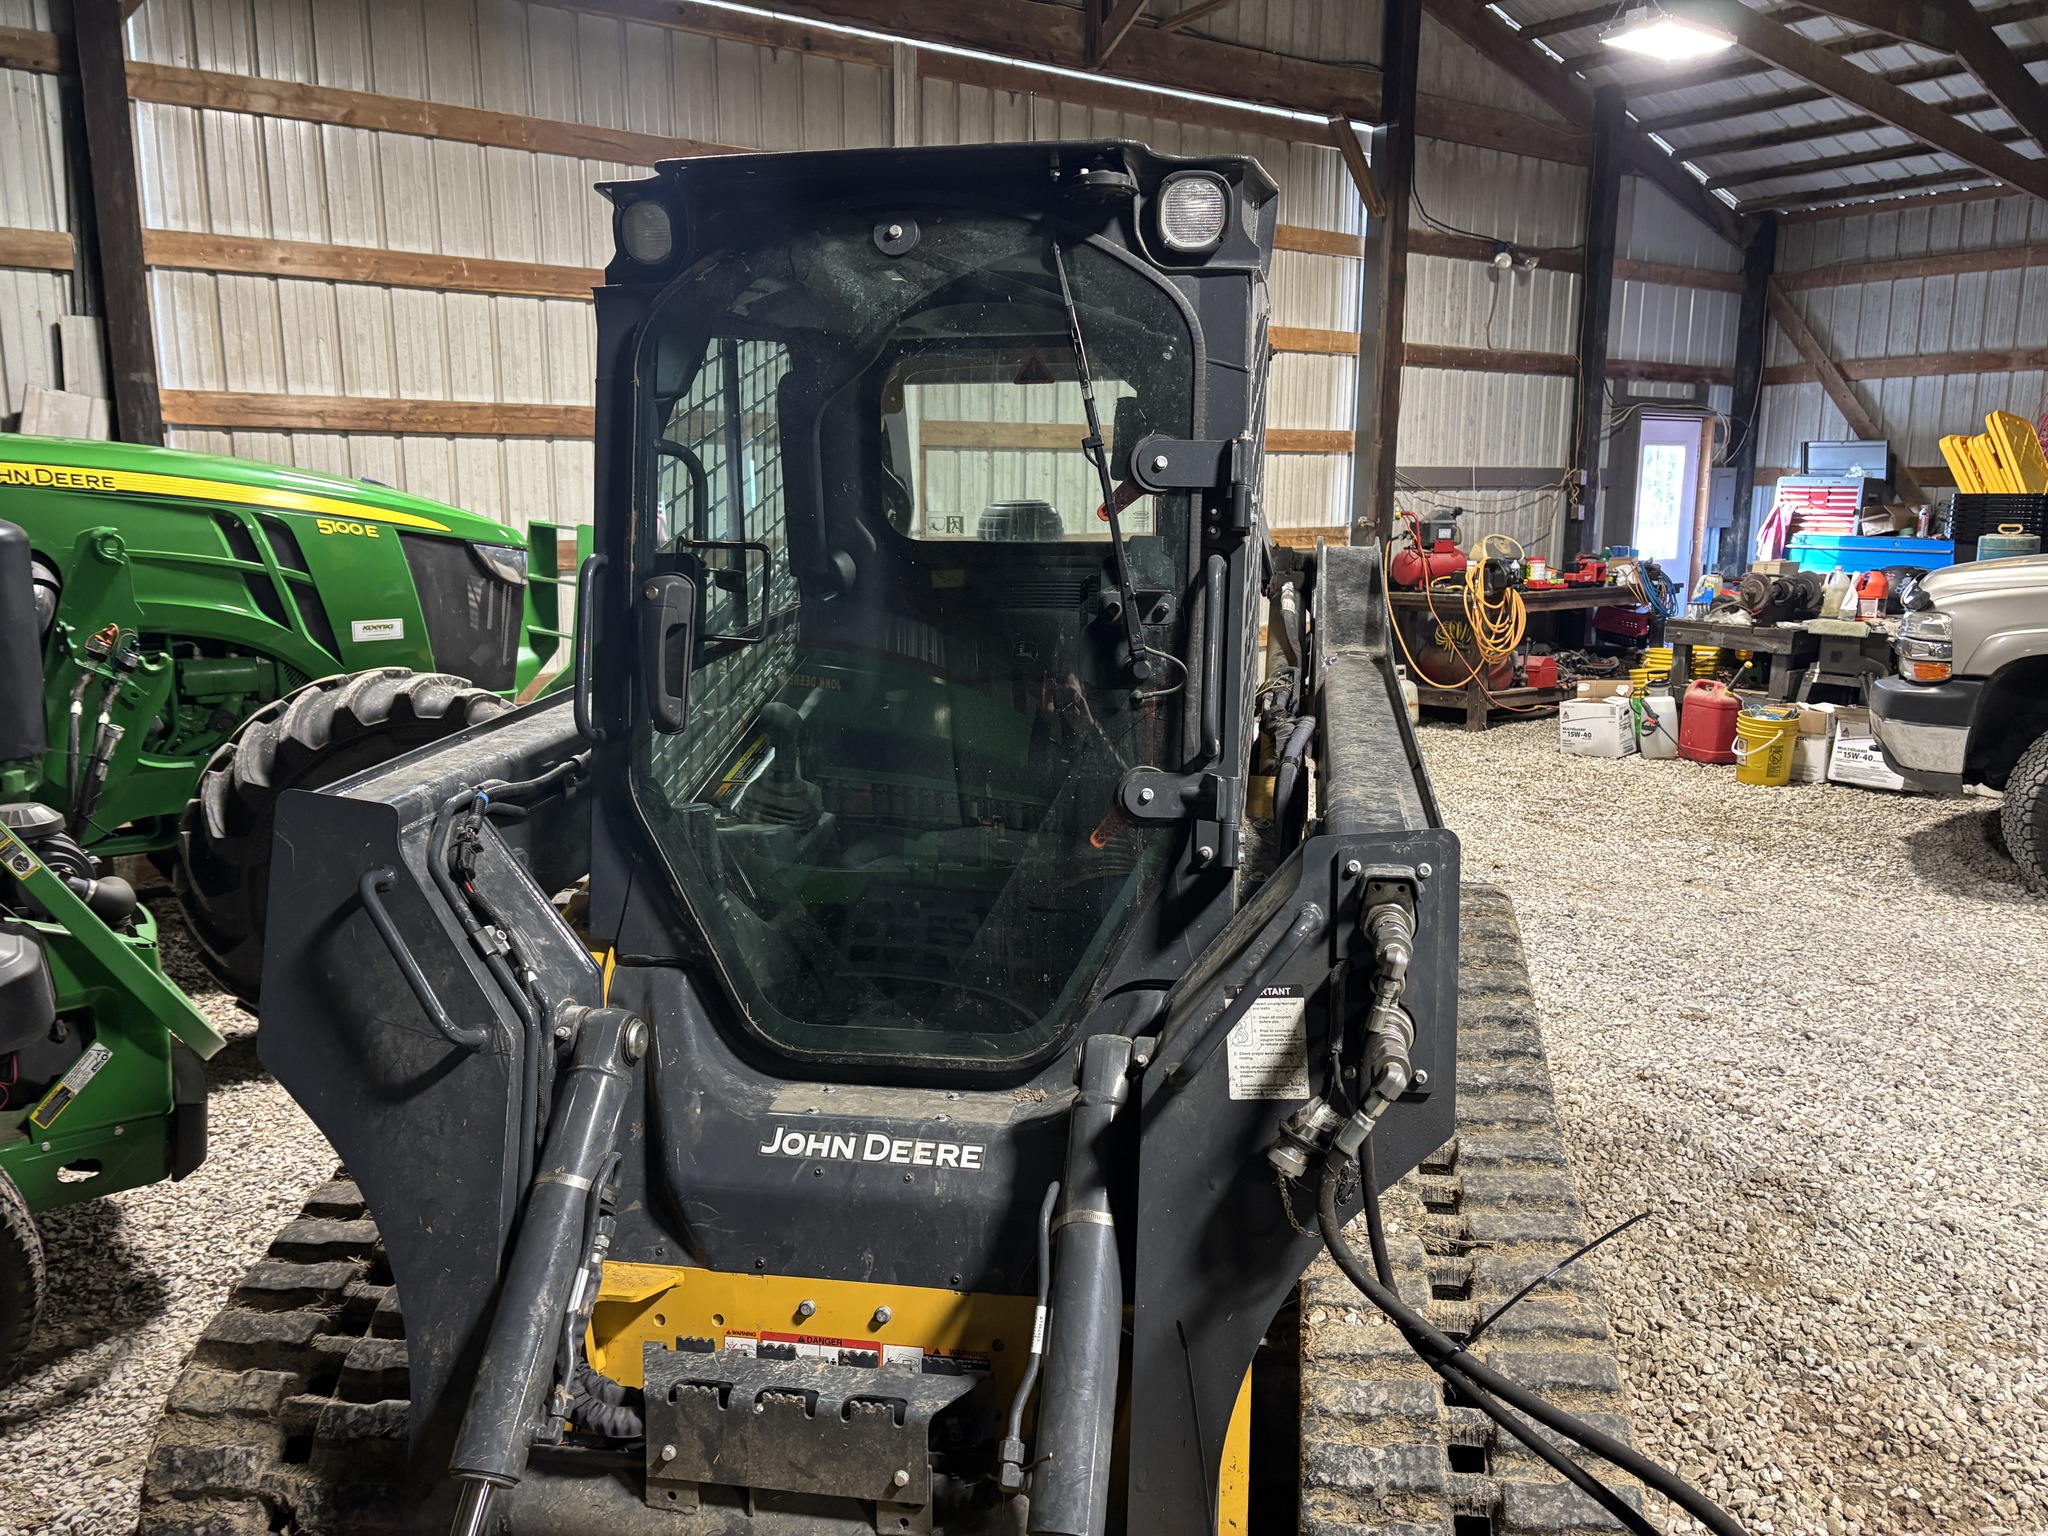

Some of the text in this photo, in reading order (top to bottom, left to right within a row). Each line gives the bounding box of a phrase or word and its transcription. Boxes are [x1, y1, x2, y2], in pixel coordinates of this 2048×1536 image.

[35, 468, 116, 488] DEERE
[316, 518, 380, 538] 5100 E
[1567, 730, 1592, 738] 15W-40
[1837, 745, 1868, 753] MULTIGUARD
[1843, 751, 1874, 762] 15W-40
[759, 1126, 985, 1170] JOHN DEERE
[731, 1330, 757, 1338] WARNING
[806, 1335, 844, 1347] DANGER
[948, 1348, 989, 1359] WARNING
